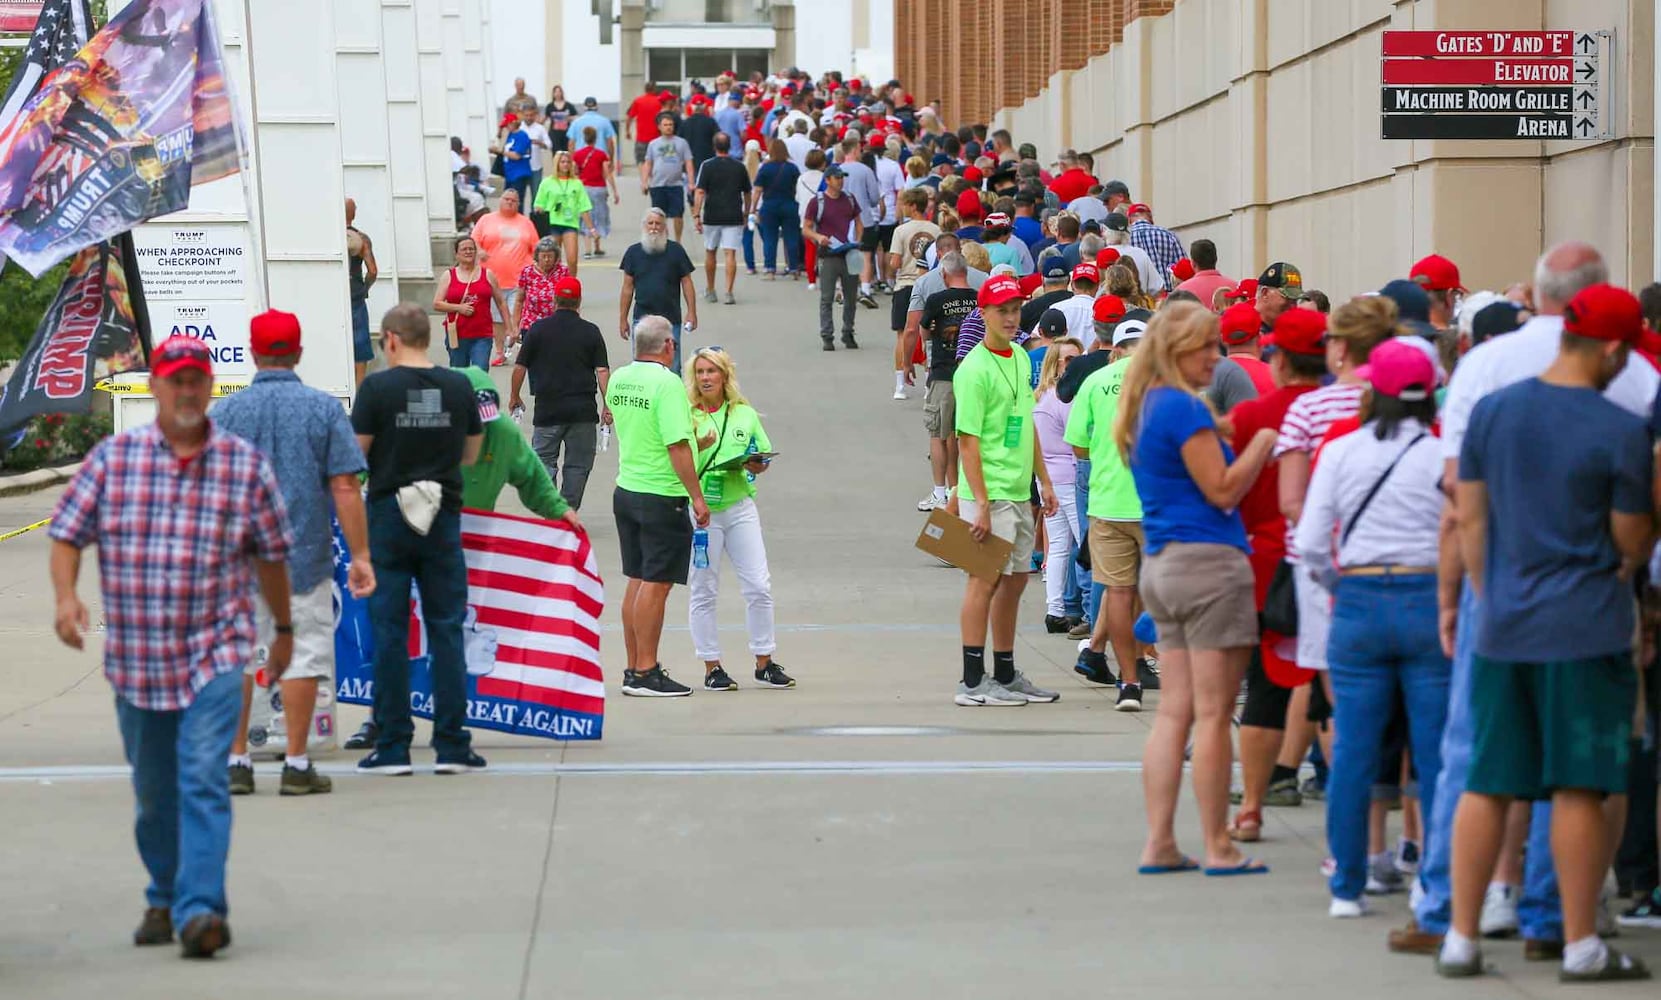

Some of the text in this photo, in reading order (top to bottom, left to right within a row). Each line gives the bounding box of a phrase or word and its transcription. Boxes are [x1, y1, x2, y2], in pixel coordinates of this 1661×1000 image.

[1436, 33, 1483, 53] GATES
[1546, 33, 1569, 53] "E"
[1495, 62, 1569, 81] ELEVATOR
[1395, 89, 1569, 109] MACHINE ROOM GRILLE
[1517, 116, 1568, 136] ARENA
[136, 247, 243, 256] WHEN APPROACHING
[157, 257, 222, 266] CHECKPOINT
[942, 299, 961, 310] ONE
[944, 306, 972, 316] UNDER
[169, 324, 217, 341] ADA
[629, 396, 650, 410] HERE
[465, 701, 517, 725] REAT
[519, 706, 593, 736] AGAIN!
